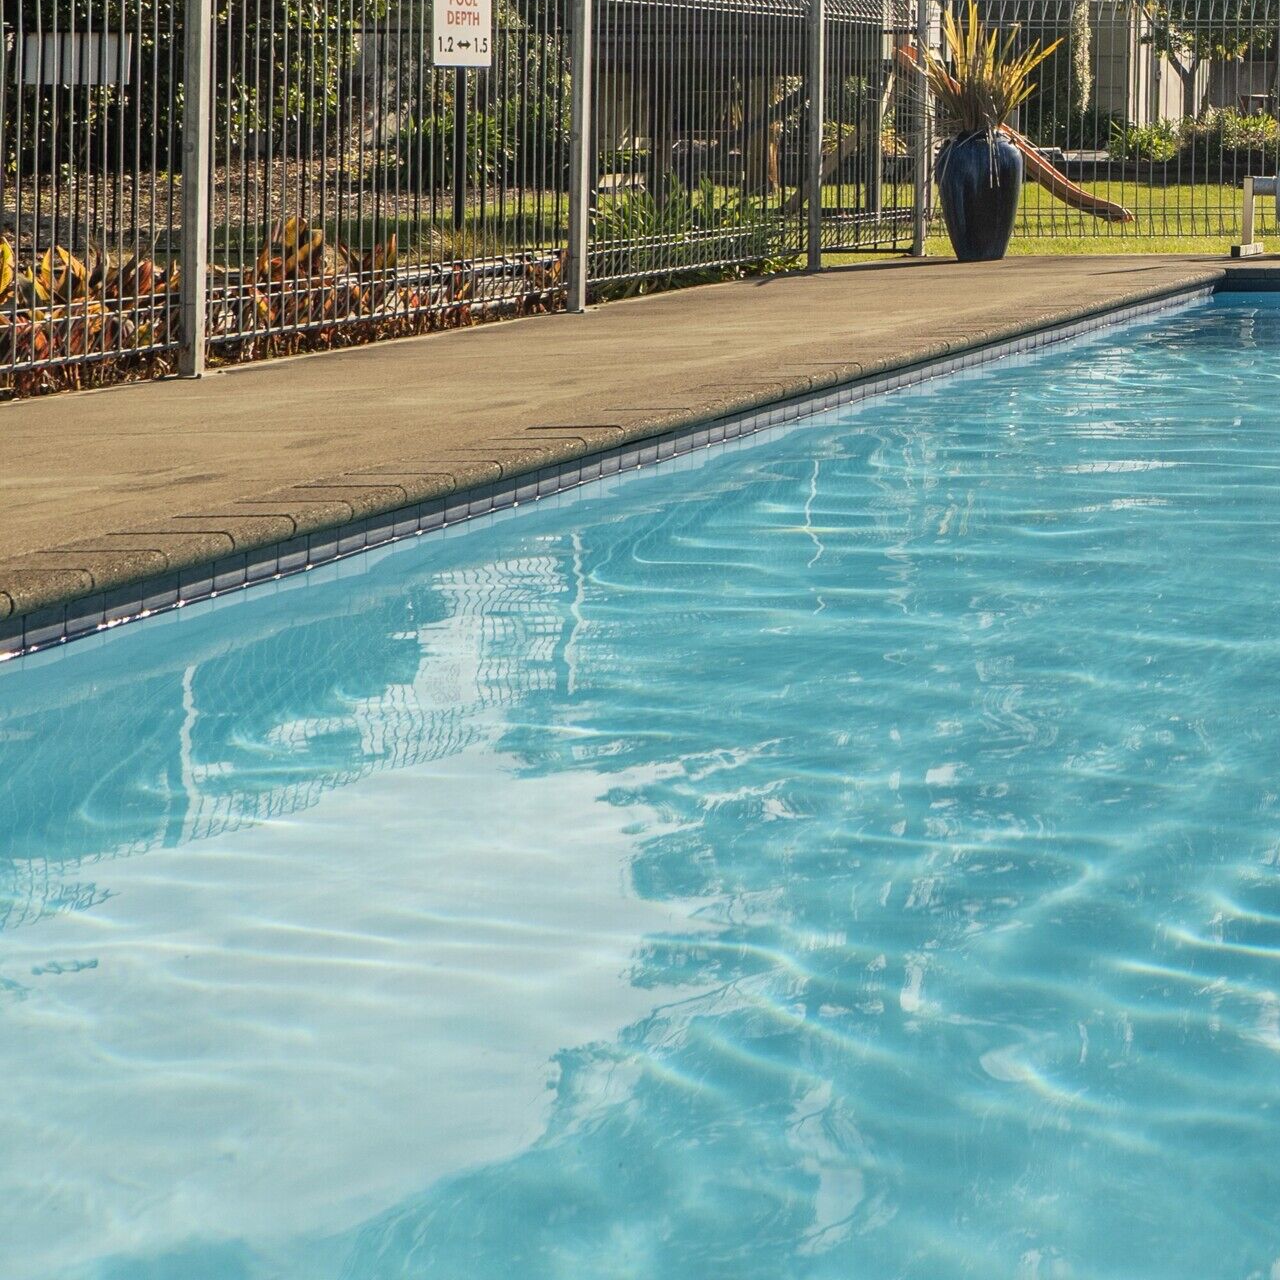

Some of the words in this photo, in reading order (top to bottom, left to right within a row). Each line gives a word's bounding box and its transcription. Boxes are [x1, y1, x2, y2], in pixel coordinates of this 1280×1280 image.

[447, 10, 480, 26] DEPTH
[438, 36, 454, 53] 1.2
[474, 37, 488, 54] 1.5
